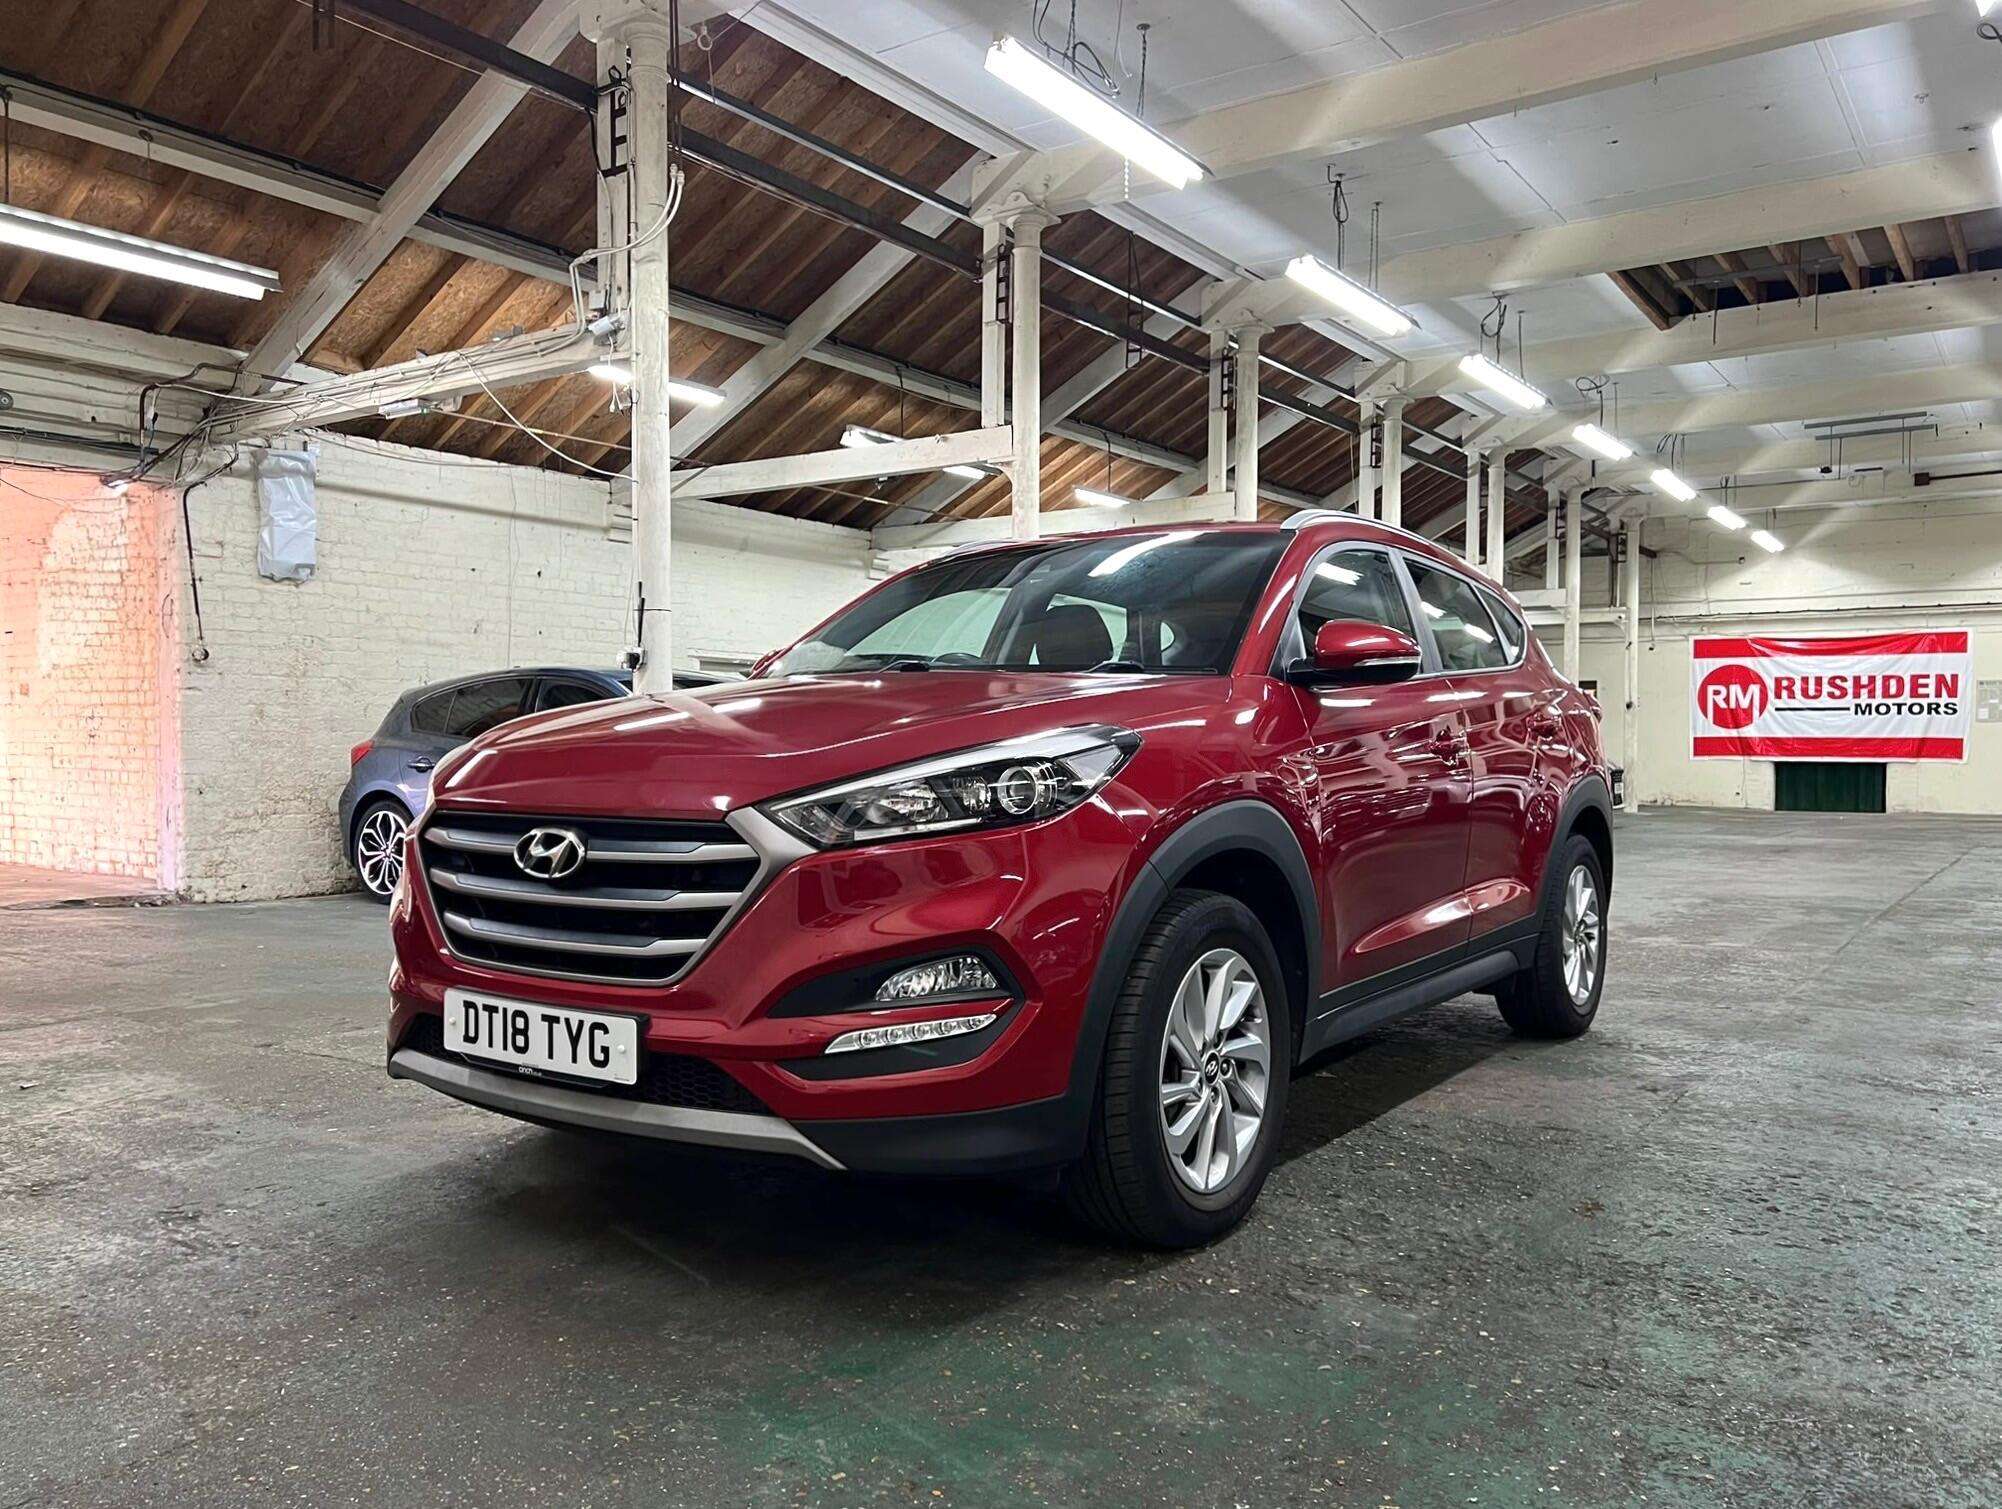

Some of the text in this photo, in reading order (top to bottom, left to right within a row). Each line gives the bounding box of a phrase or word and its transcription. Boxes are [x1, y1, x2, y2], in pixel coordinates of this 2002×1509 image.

[1774, 674, 1958, 699] RUSHDEN
[1707, 684, 1760, 722] RM
[1854, 702, 1958, 716] MOTORS
[463, 1000, 610, 1068] DT18 TYG
